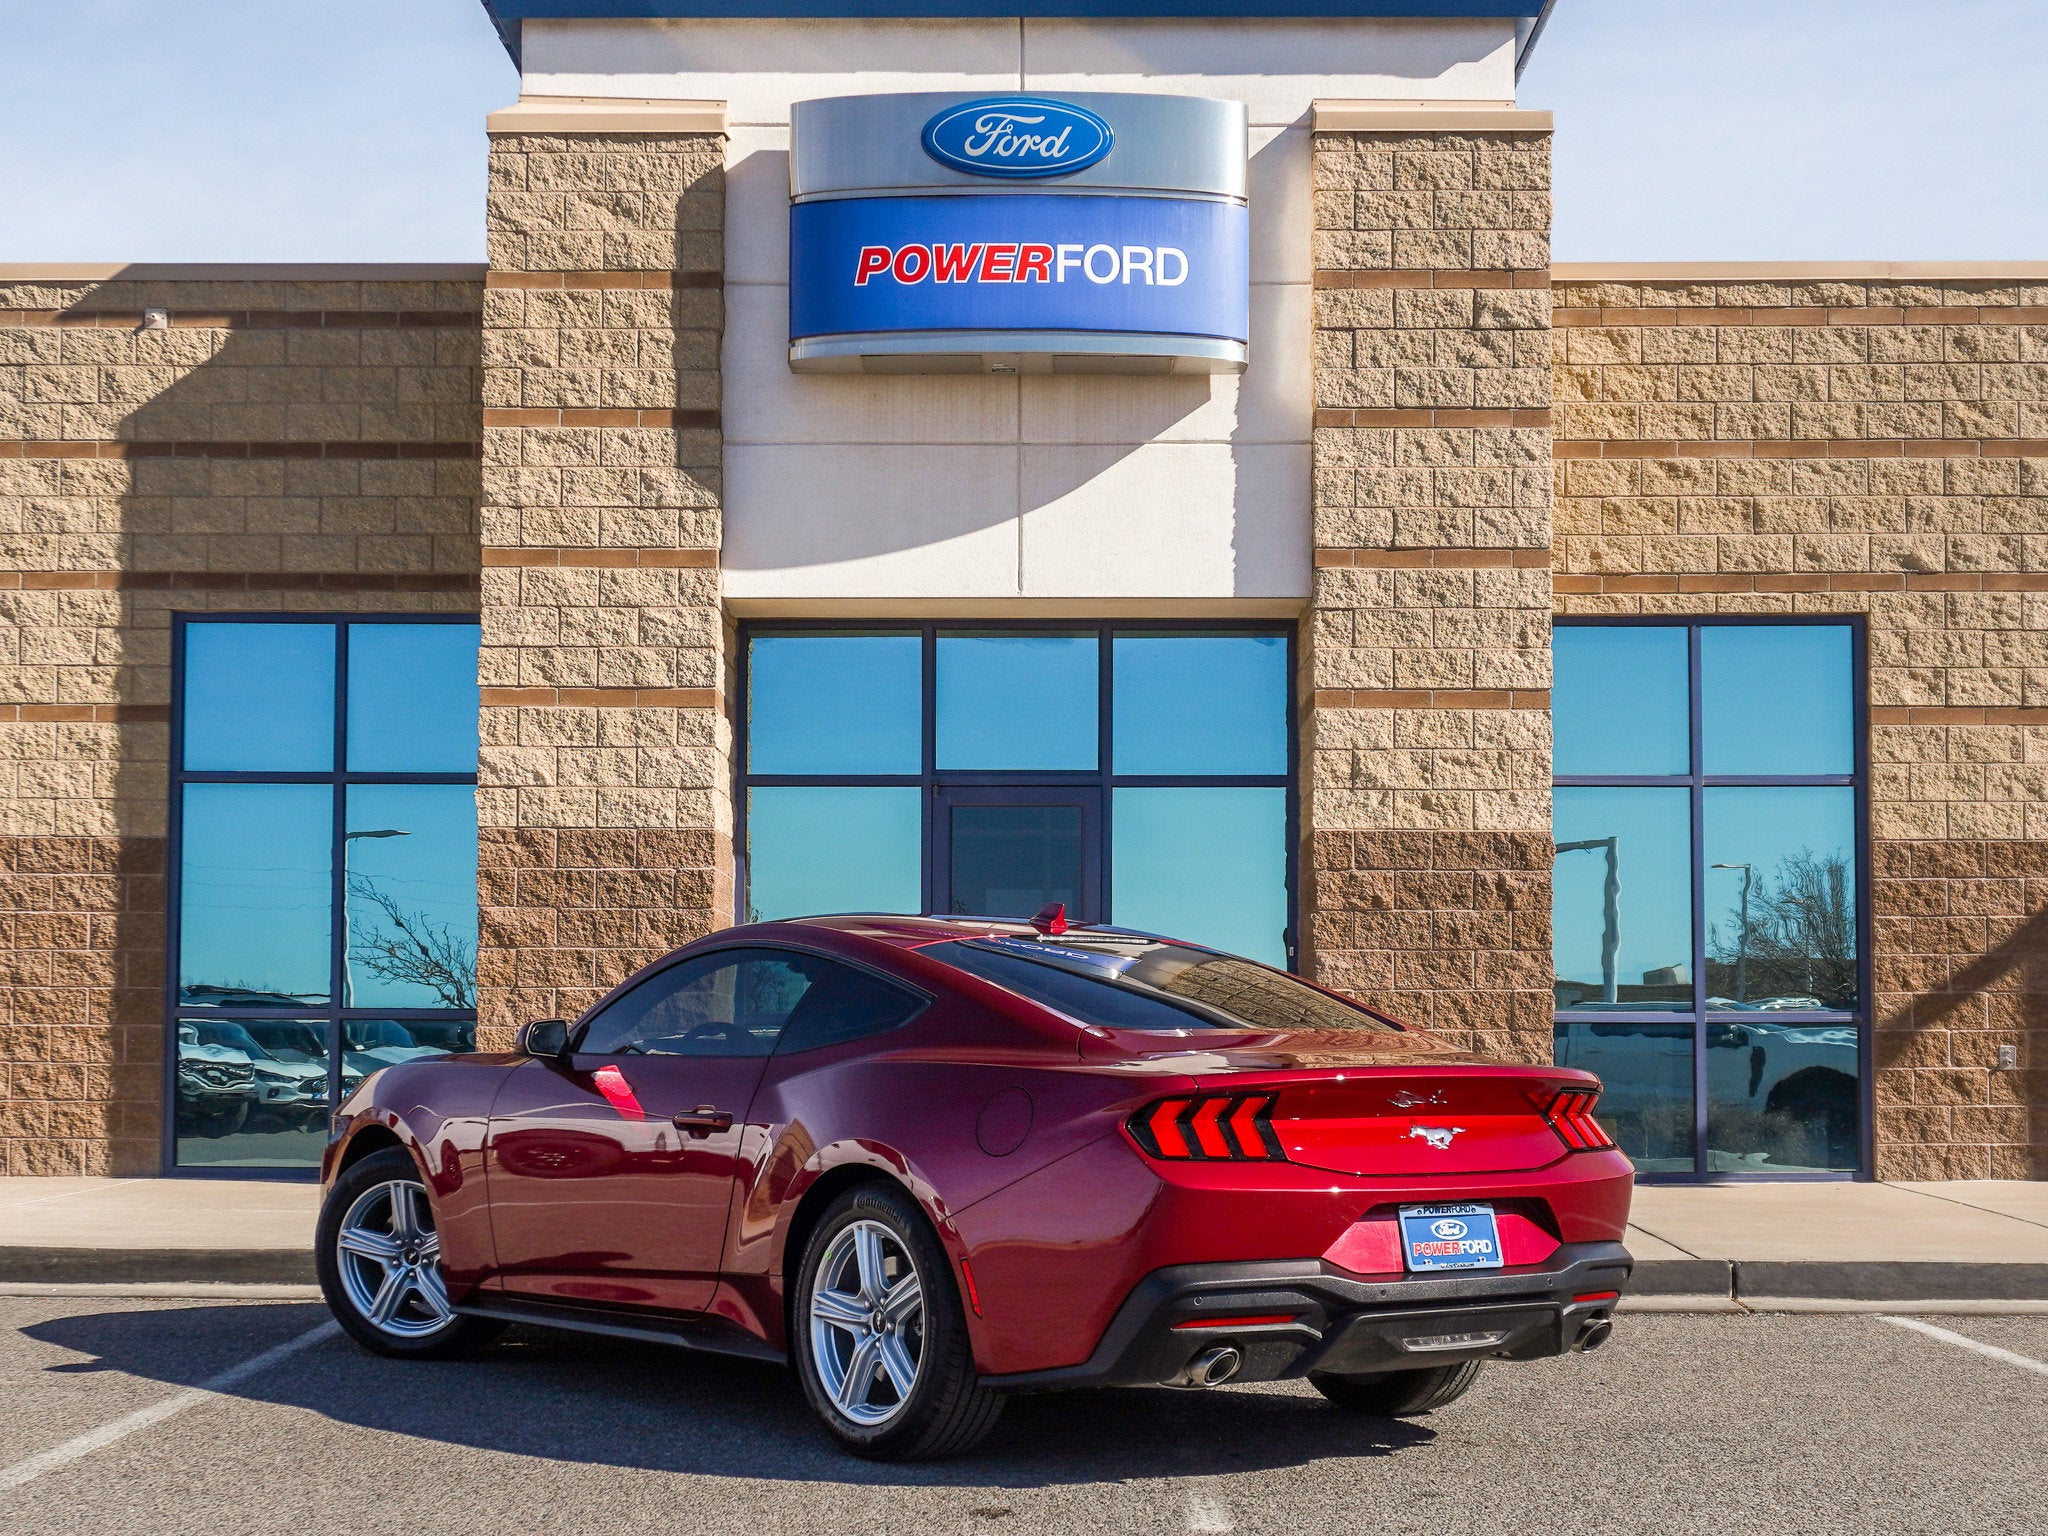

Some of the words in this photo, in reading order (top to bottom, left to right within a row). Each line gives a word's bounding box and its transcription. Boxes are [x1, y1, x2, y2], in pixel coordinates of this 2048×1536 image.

[964, 112, 1072, 158] Ford
[854, 242, 1189, 287] POWERFORD
[1439, 1222, 1461, 1236] Ford
[1412, 1239, 1493, 1257] POWERFORD
